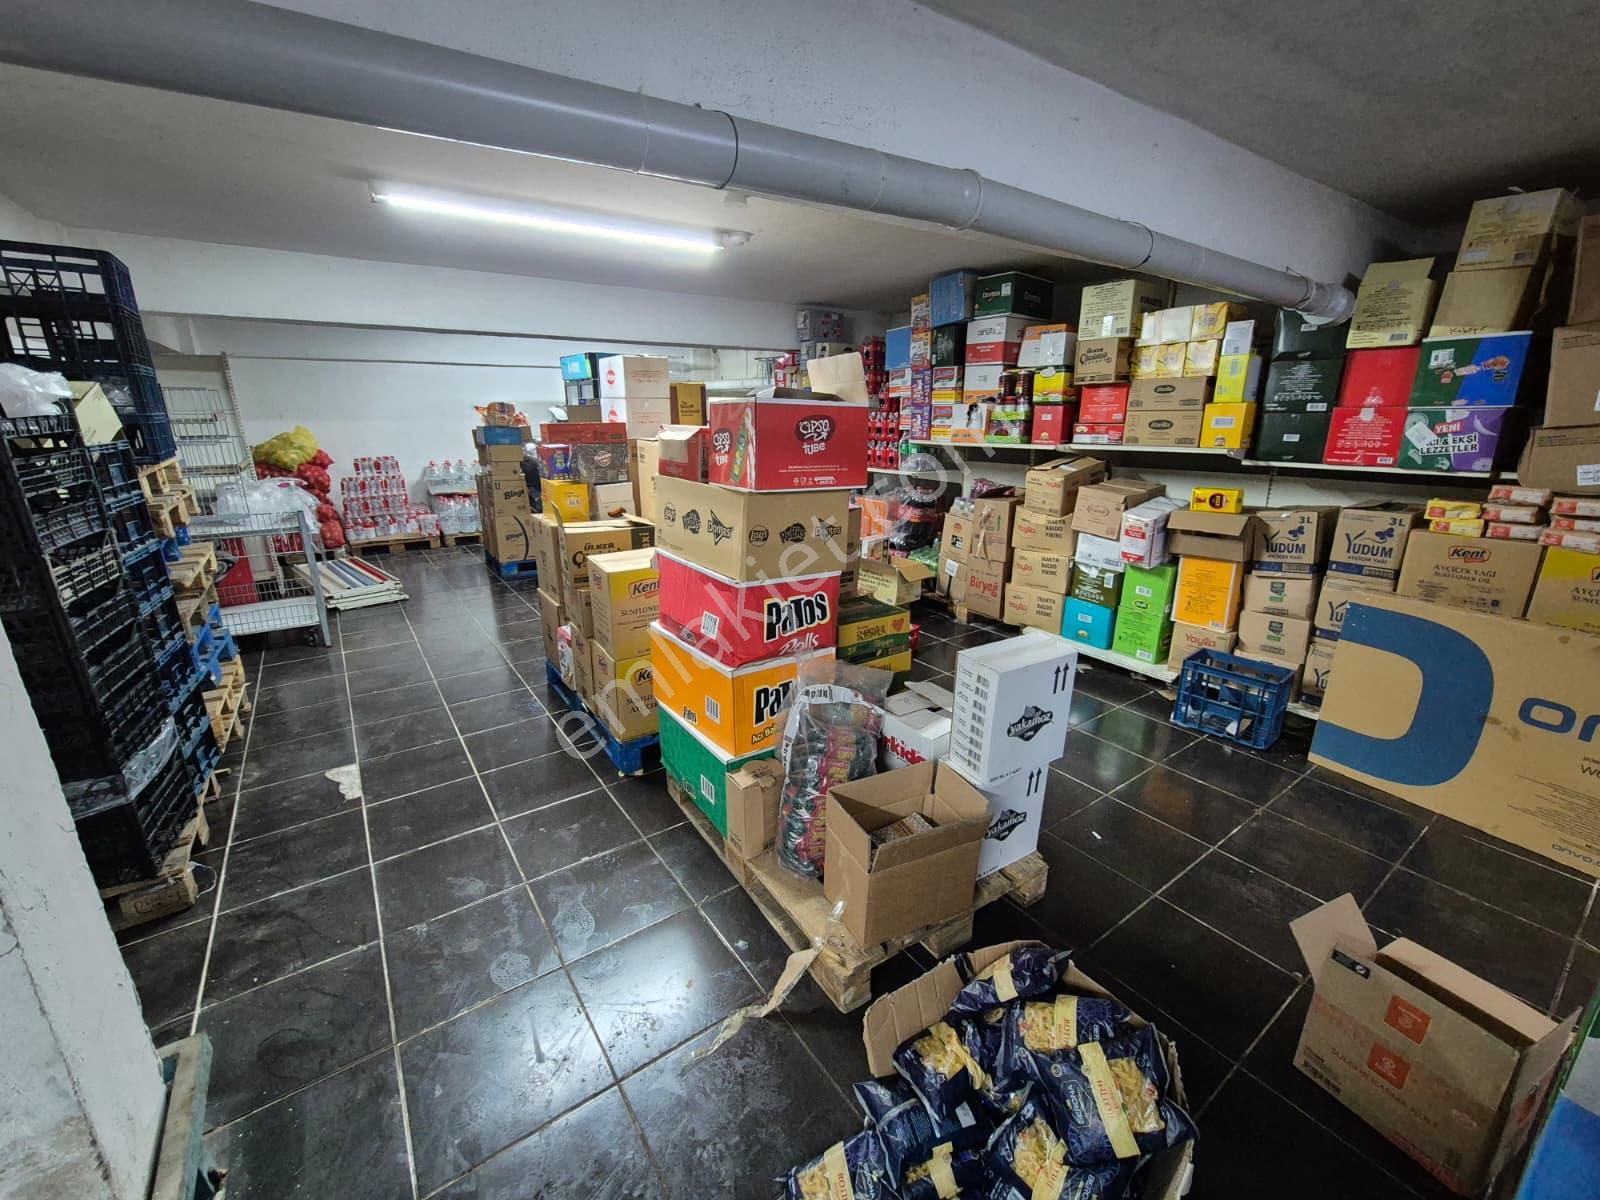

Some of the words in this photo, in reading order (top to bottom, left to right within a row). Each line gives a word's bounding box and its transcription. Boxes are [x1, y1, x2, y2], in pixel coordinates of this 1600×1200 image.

[1420, 443, 1479, 455] LEZZETLER
[1263, 530, 1306, 554] YUDUM
[1344, 530, 1394, 558] YUDUM
[1450, 547, 1487, 558] Kent
[969, 575, 999, 598] Biryağ
